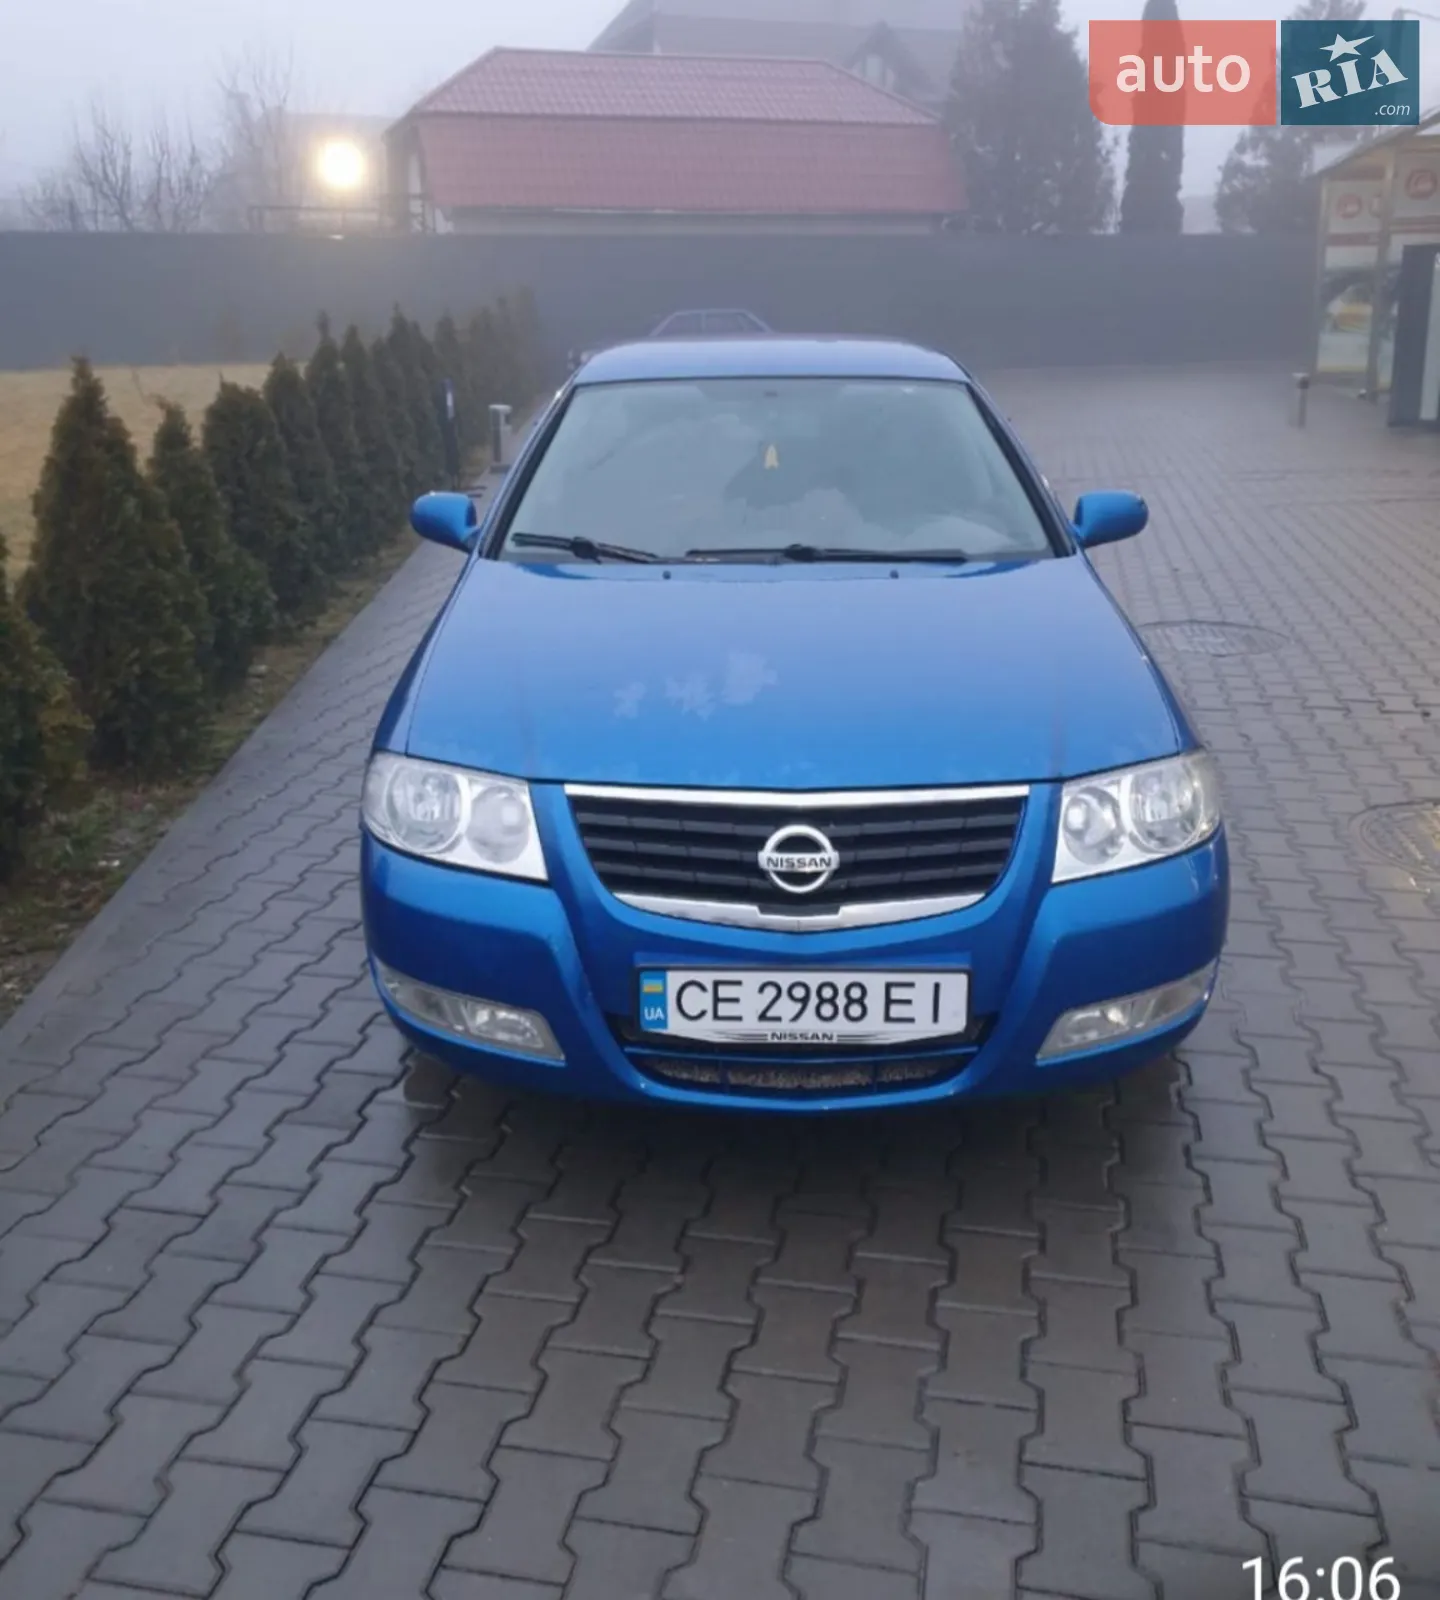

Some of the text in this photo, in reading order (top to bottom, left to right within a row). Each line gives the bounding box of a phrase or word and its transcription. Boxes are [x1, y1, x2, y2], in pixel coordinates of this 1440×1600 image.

[766, 857, 832, 869] NISSAN
[643, 1007, 665, 1022] UA
[675, 979, 743, 1022] CE
[757, 981, 868, 1024] 2988
[771, 1031, 834, 1042] NISSAN
